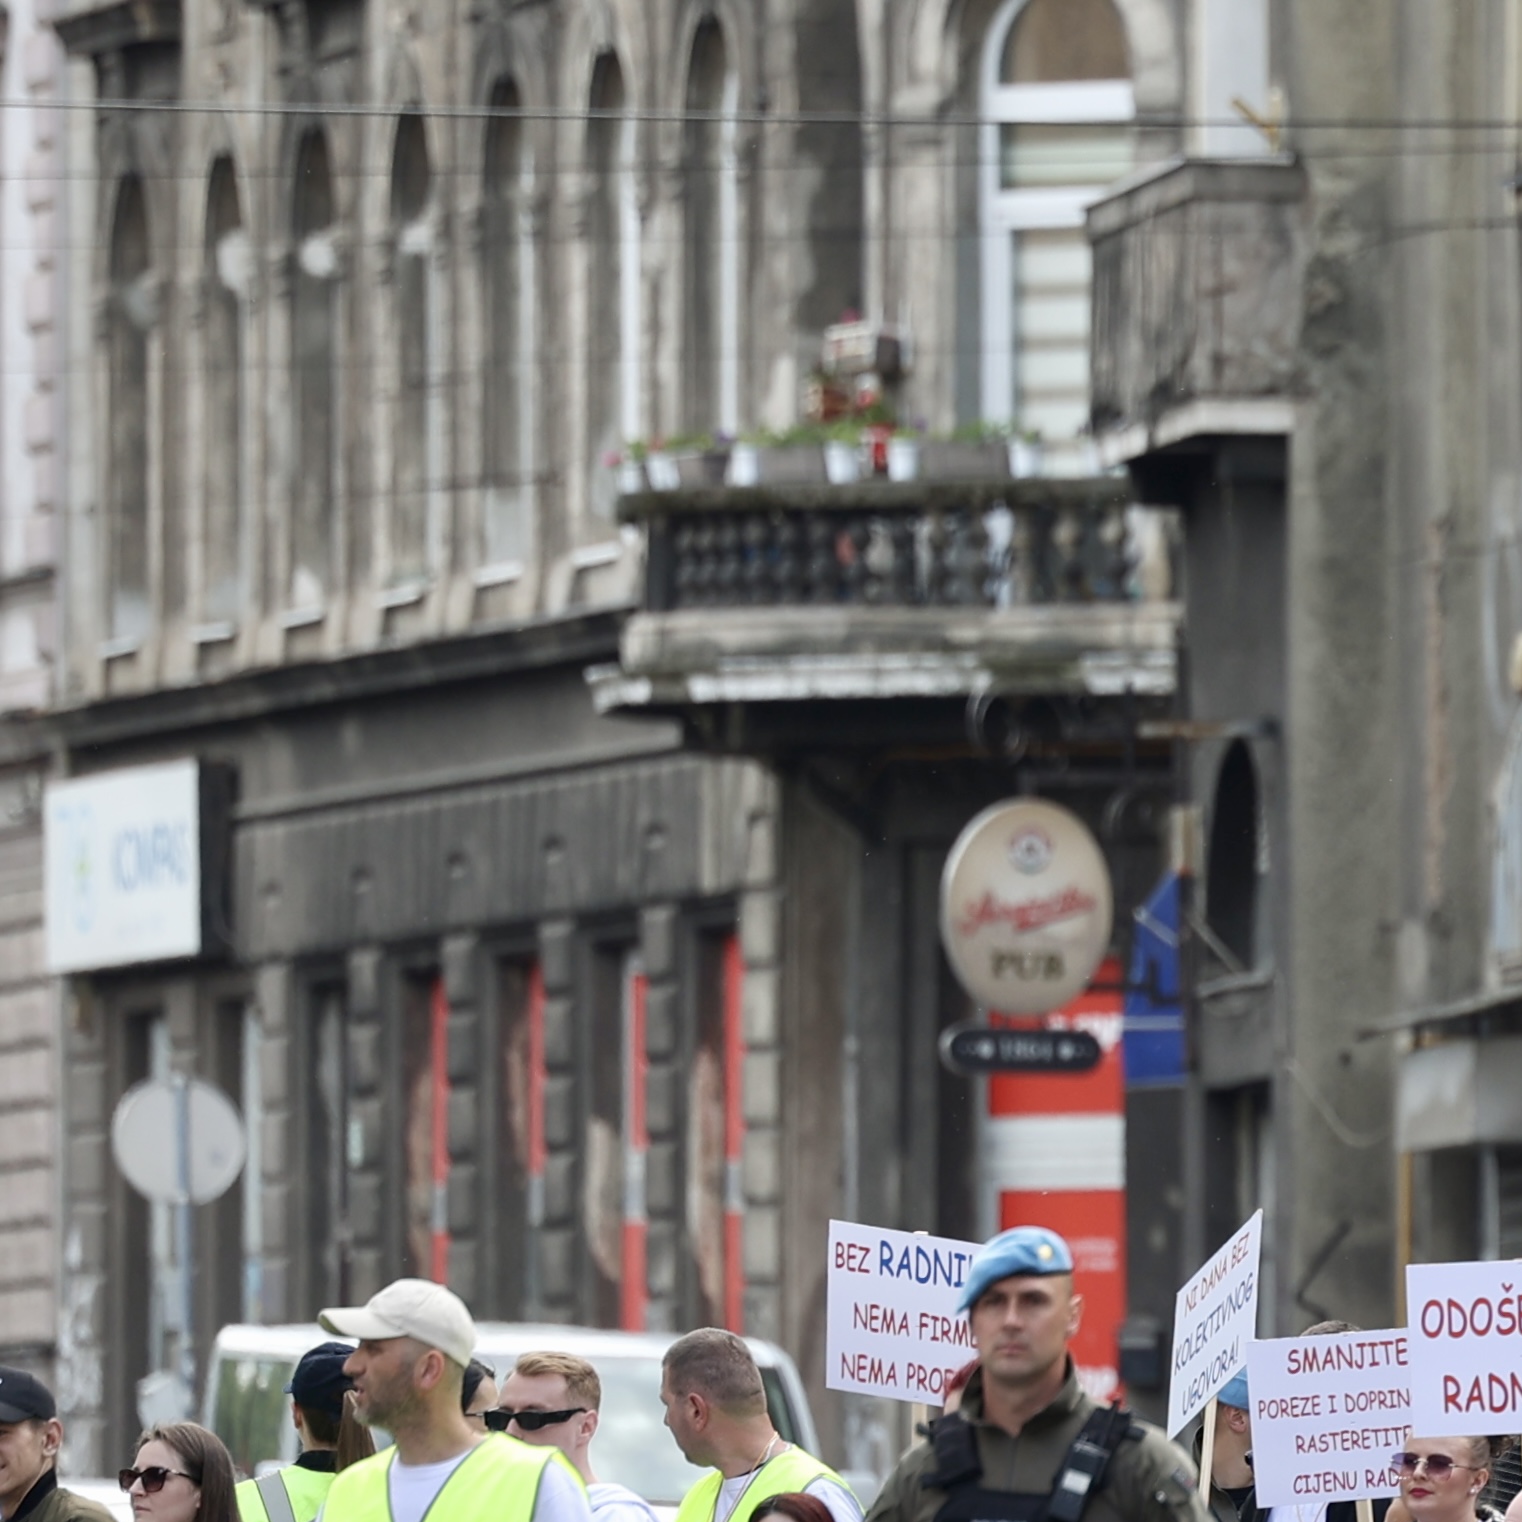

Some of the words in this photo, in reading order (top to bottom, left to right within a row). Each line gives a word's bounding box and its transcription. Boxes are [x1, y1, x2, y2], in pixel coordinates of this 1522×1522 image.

[991, 951, 1064, 981] PUB
[835, 1241, 871, 1274] BEZ
[879, 1239, 972, 1288] RADNI
[1184, 1284, 1199, 1318] NI
[1201, 1254, 1228, 1301] DANA
[1231, 1232, 1250, 1270] BEZ
[853, 1301, 910, 1337] NEMA
[1174, 1272, 1254, 1376] KOLEKTIVNOG
[841, 1352, 898, 1387] NEMA
[1287, 1338, 1409, 1375] SMANJITE
[1182, 1335, 1240, 1416] UGOVORA!
[1258, 1395, 1322, 1420] POREZE
[1328, 1395, 1338, 1414] I
[1344, 1388, 1411, 1413] DOPRIN
[1293, 1471, 1358, 1494] CIJENU
[1365, 1467, 1401, 1489] RAD
